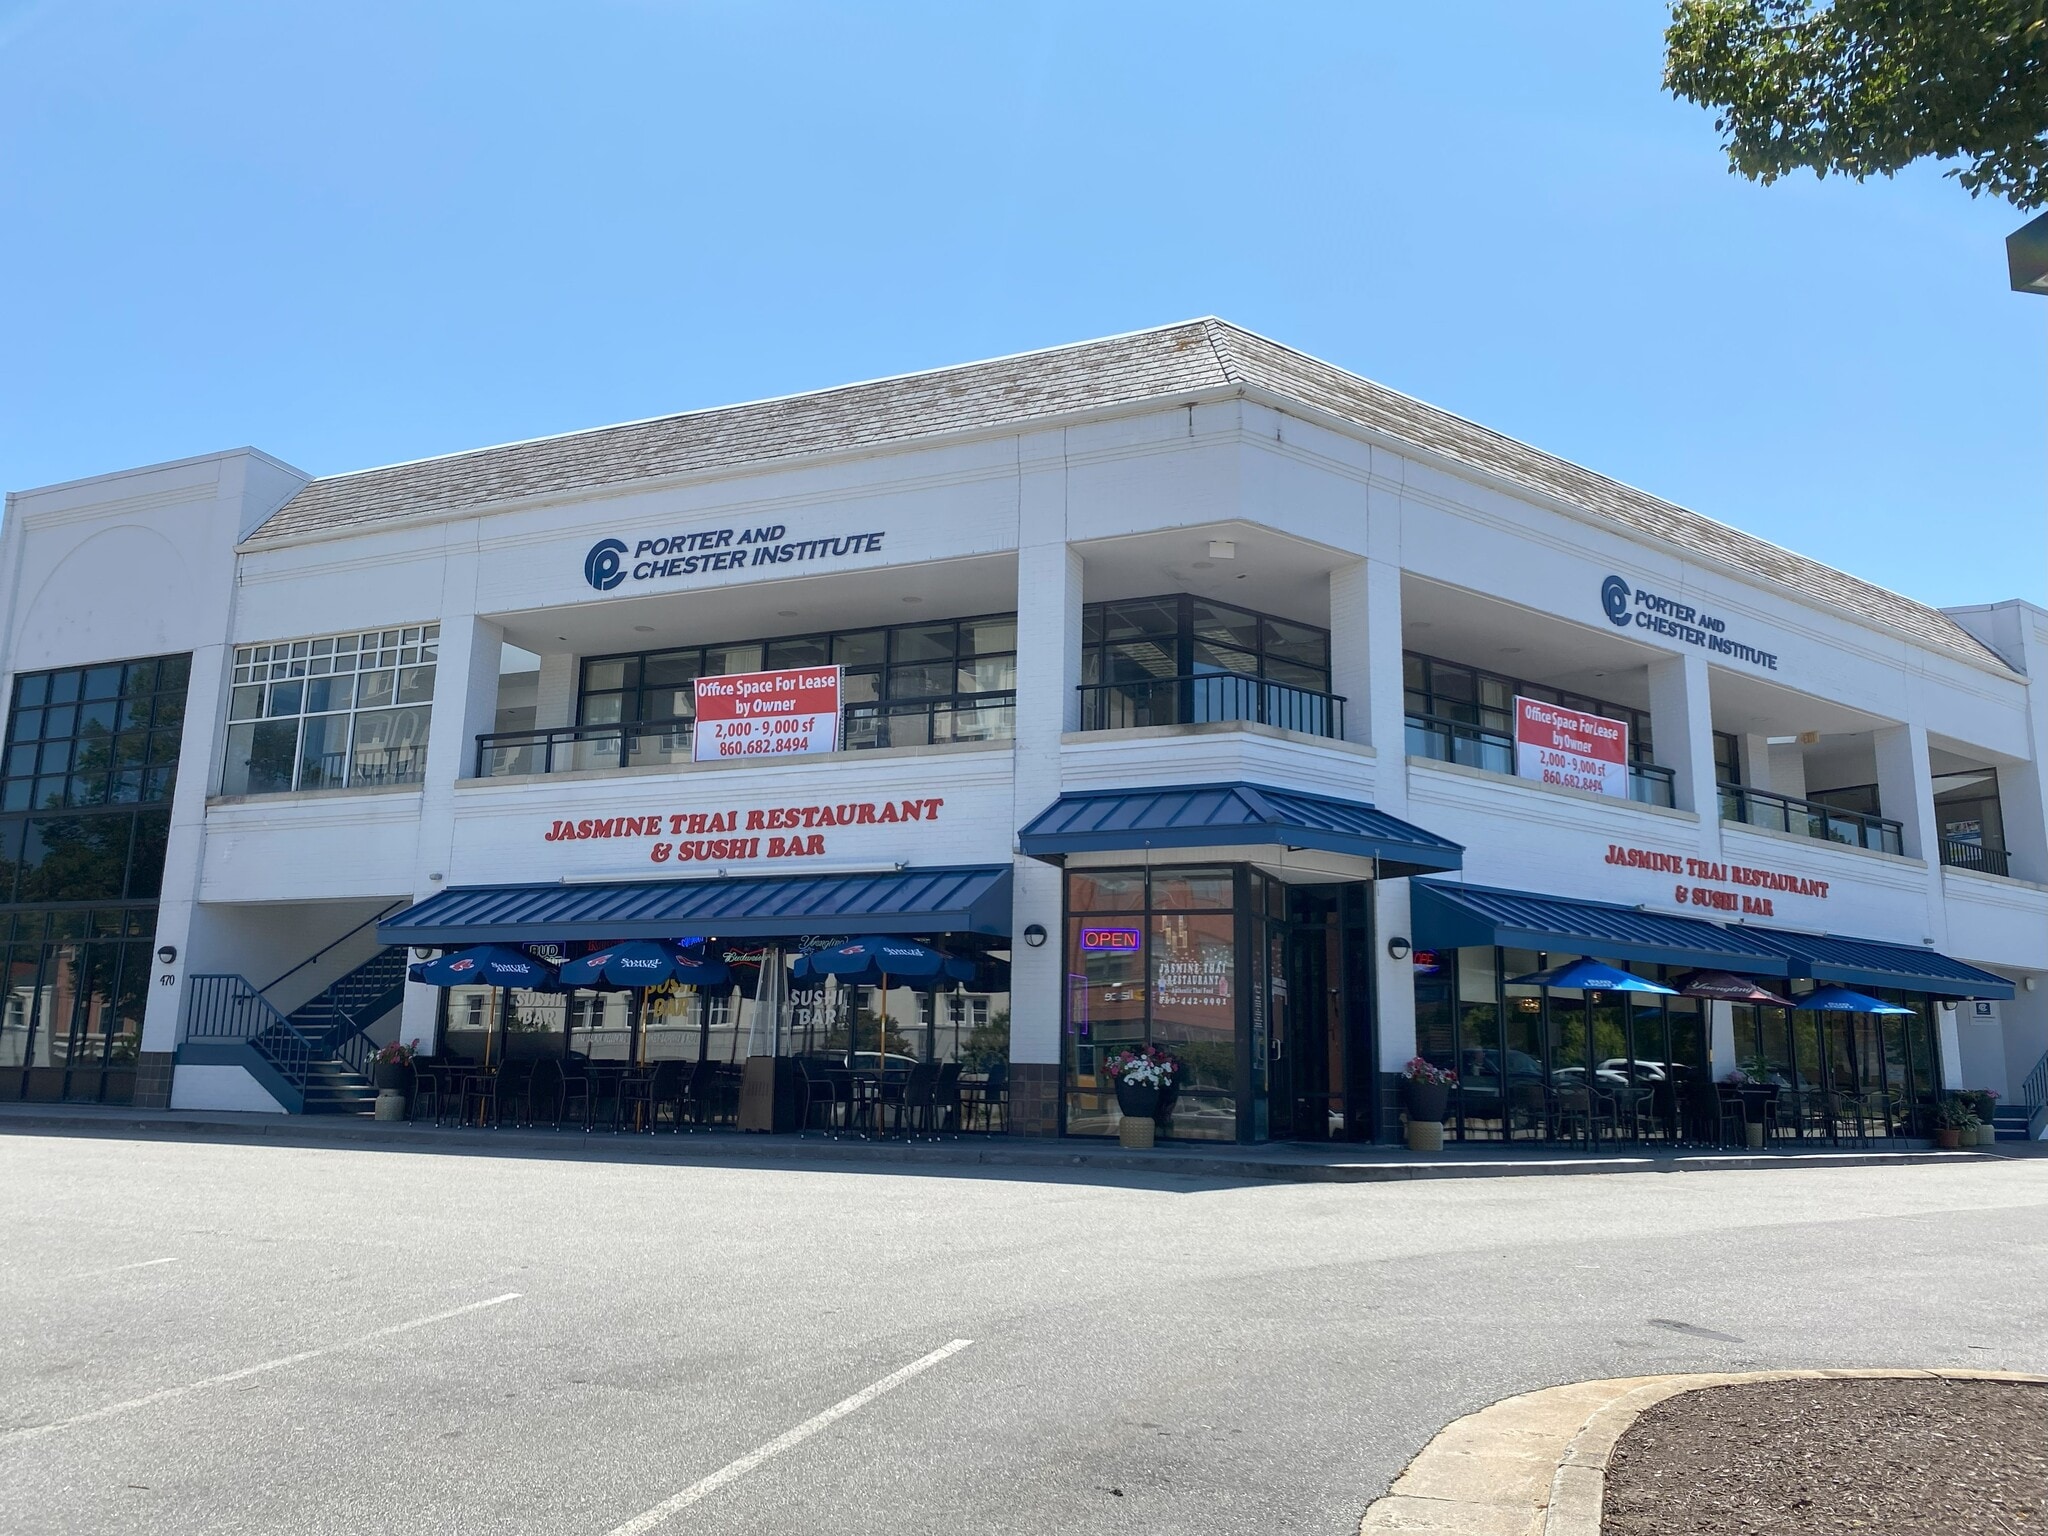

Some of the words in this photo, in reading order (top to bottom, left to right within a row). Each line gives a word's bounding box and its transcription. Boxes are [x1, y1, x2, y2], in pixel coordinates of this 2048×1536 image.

[634, 528, 733, 559] PORTER
[736, 525, 786, 546] AND
[632, 549, 746, 580] CHESTER
[752, 531, 885, 565] INSTITUTE
[1634, 589, 1696, 624] PORTER
[1698, 614, 1725, 633] AND
[1635, 612, 1706, 647] CHESTER
[1708, 634, 1778, 671] INSTITUTE
[698, 681, 734, 697] Office
[736, 679, 773, 698] Space
[775, 676, 796, 692] For
[799, 675, 836, 689] Lease
[735, 700, 750, 717] by
[753, 698, 796, 713] Owner
[715, 722, 751, 740] 2,000
[762, 719, 799, 737] 9,000
[802, 717, 815, 733] sf
[1525, 705, 1552, 724] Office
[1552, 712, 1578, 731] Space
[1580, 719, 1594, 734] For
[1593, 721, 1619, 740] Lease
[720, 737, 809, 756] 860.682.8494
[1552, 731, 1564, 749] by
[1564, 734, 1592, 753] Owner
[1540, 750, 1566, 768] 2,000
[1572, 757, 1597, 775] 9,000
[1598, 763, 1606, 777] sf
[545, 815, 662, 841] JASMINE
[669, 810, 737, 835] THAI
[746, 798, 944, 831] RESTAURANT
[650, 843, 671, 863] &
[678, 837, 760, 862] SUSHI
[767, 834, 826, 858] BAR
[1605, 844, 1683, 874] JASMINE
[1687, 858, 1727, 881] THAI
[1731, 865, 1829, 898] RESTAURANT
[1675, 885, 1688, 903] &
[1692, 887, 1738, 911] SUSHI
[1742, 895, 1774, 916] BAR
[1086, 932, 1136, 946] OPEN
[1159, 963, 1200, 974] JASMINE
[1203, 962, 1226, 974] THAI
[160, 974, 175, 986] 470
[1167, 975, 1220, 985] RESTAURANT
[516, 991, 564, 1007] SUSHI
[653, 998, 688, 1017] BAR
[791, 988, 844, 1006] SUSHI
[522, 1008, 557, 1025] BAR
[799, 1008, 837, 1025] BAR
